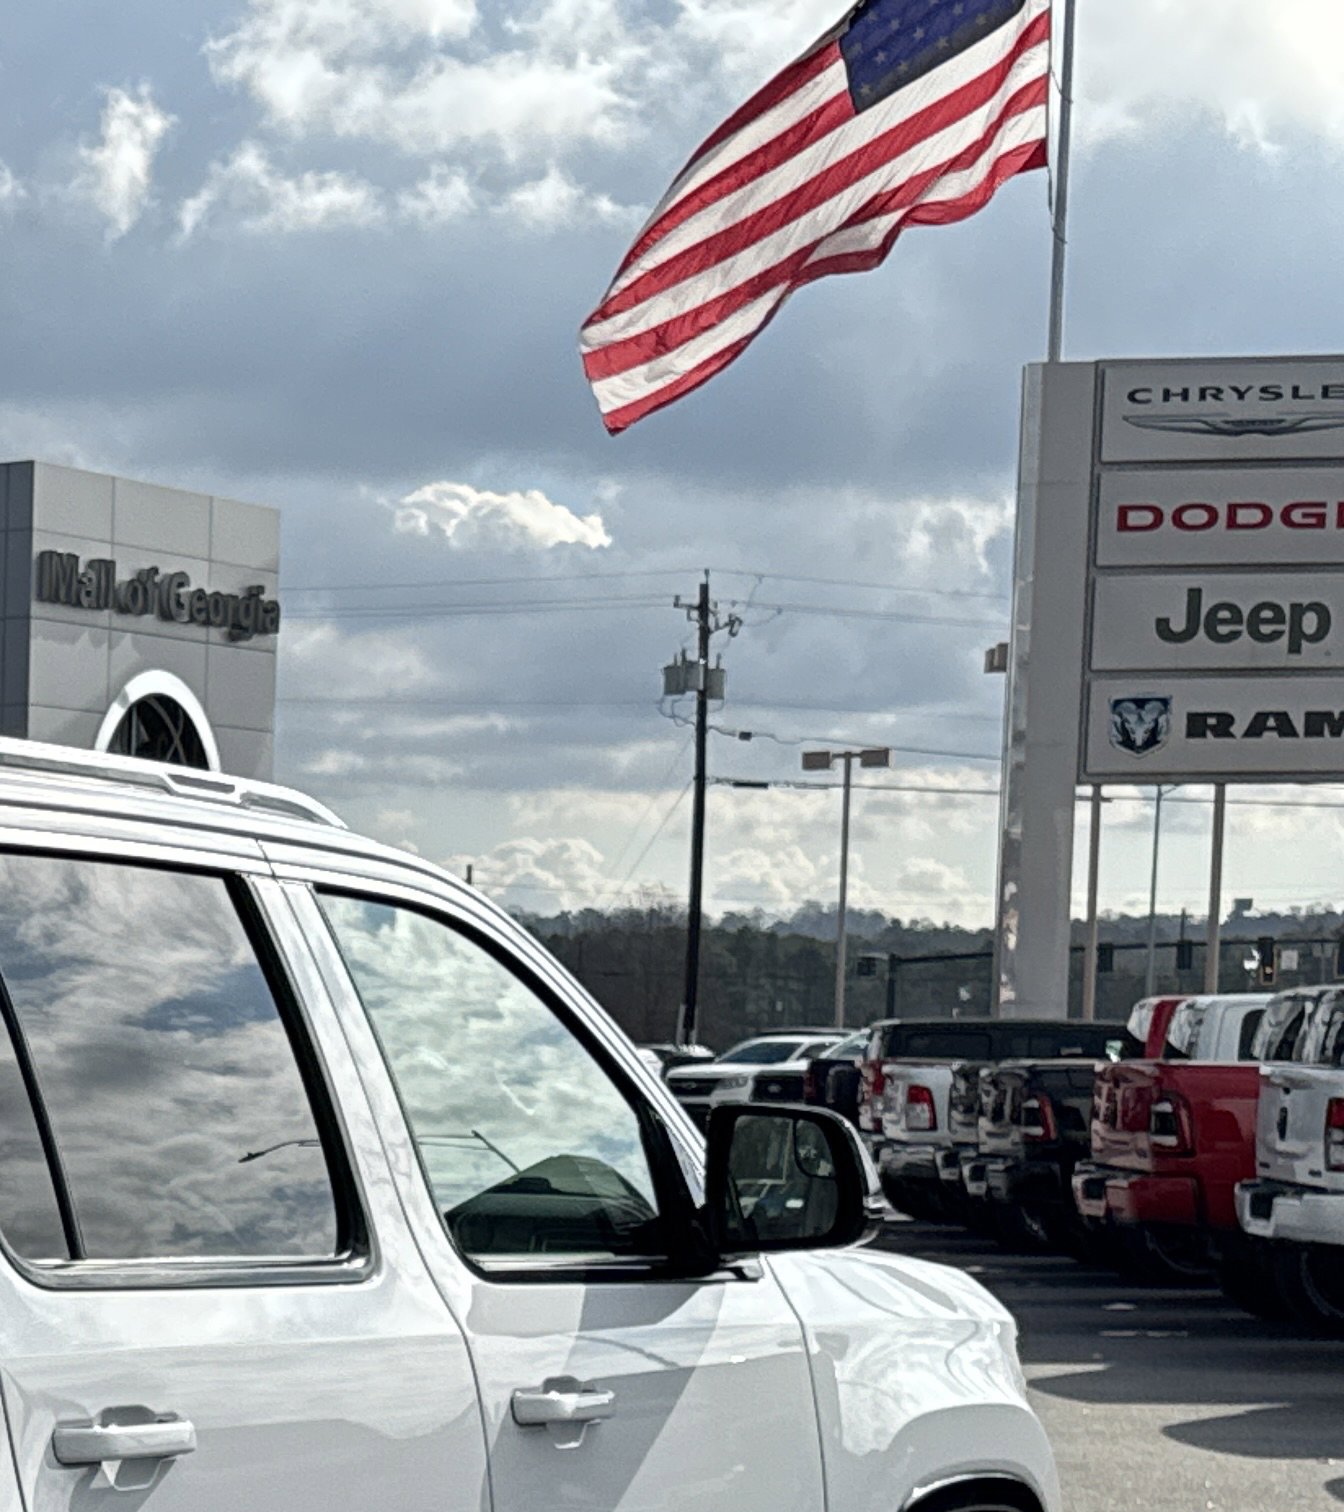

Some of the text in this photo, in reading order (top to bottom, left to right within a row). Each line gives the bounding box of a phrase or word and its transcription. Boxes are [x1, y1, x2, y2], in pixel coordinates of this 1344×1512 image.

[1116, 501, 1344, 533] DODG
[36, 550, 280, 641] Mall of Georgia
[1155, 588, 1332, 655] Jeep
[1185, 710, 1344, 740] RAM
